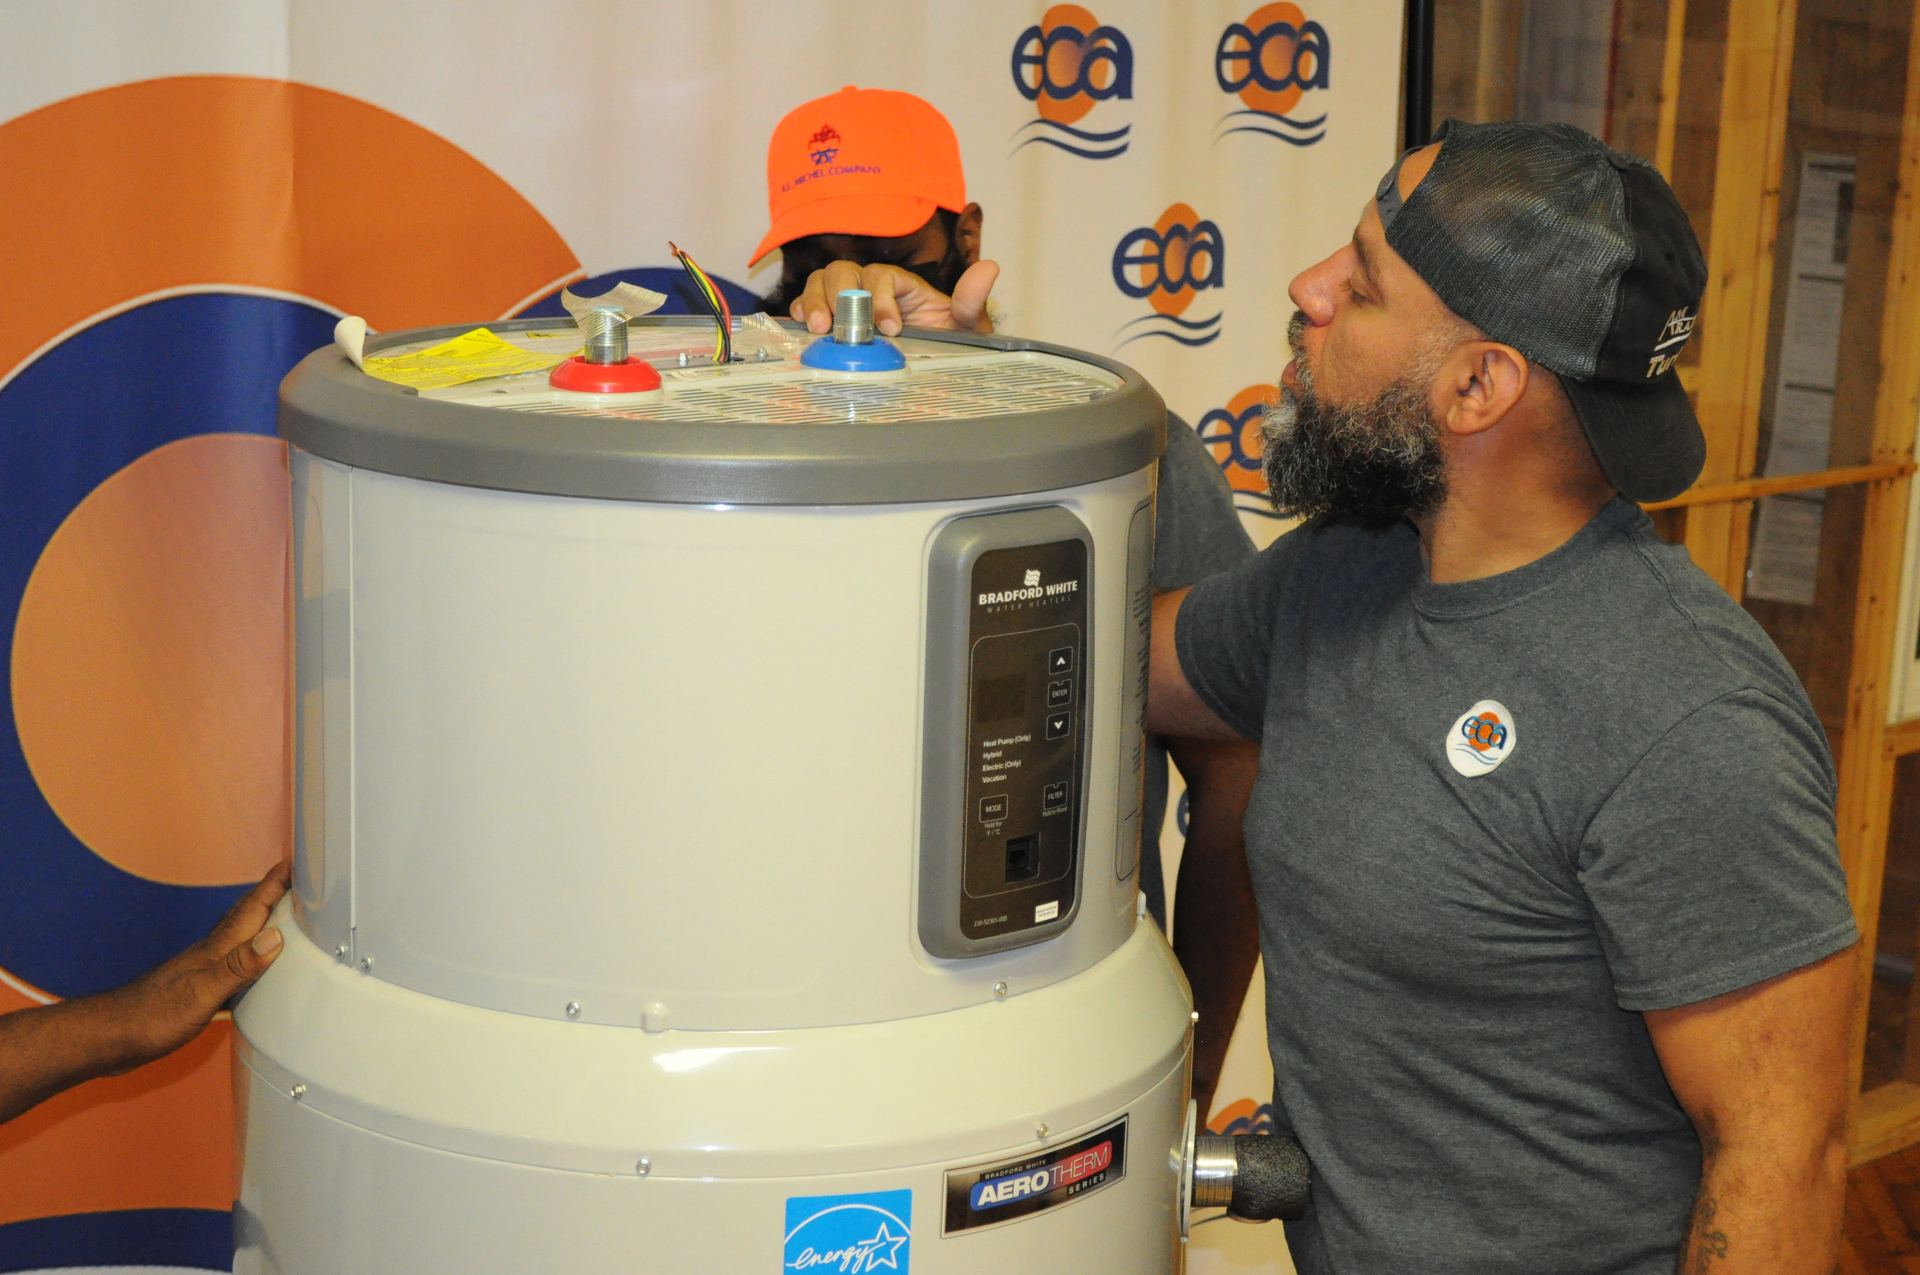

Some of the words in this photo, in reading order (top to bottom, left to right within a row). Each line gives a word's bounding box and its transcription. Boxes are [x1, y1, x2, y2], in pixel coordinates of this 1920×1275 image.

[1012, 25, 1134, 101] eca
[1215, 21, 1330, 93] eca
[828, 165, 881, 176] COMPANY
[1112, 220, 1225, 299] eca
[979, 586, 1043, 606] BRADFORD
[1046, 580, 1078, 596] WHITE
[987, 603, 1022, 614] WATER
[1029, 595, 1071, 608] HEATERS
[1052, 688, 1068, 698] ENTER
[983, 740, 997, 748] Heat
[997, 737, 1014, 746] Pump
[1014, 733, 1031, 744] (Only)
[1461, 715, 1507, 750] eca
[983, 750, 1002, 761] Hybrid
[982, 763, 1004, 772] Electric
[1004, 759, 1021, 770] (Only)
[982, 774, 1007, 783] Vacation
[1047, 790, 1063, 800] FILTER
[985, 803, 1002, 813] MODE
[984, 821, 996, 829] Hold
[985, 1165, 1023, 1180] BRADFORD
[1025, 1158, 1047, 1170] WHITE
[1068, 1172, 1105, 1195] SERIES
[786, 1243, 881, 1275] energy
